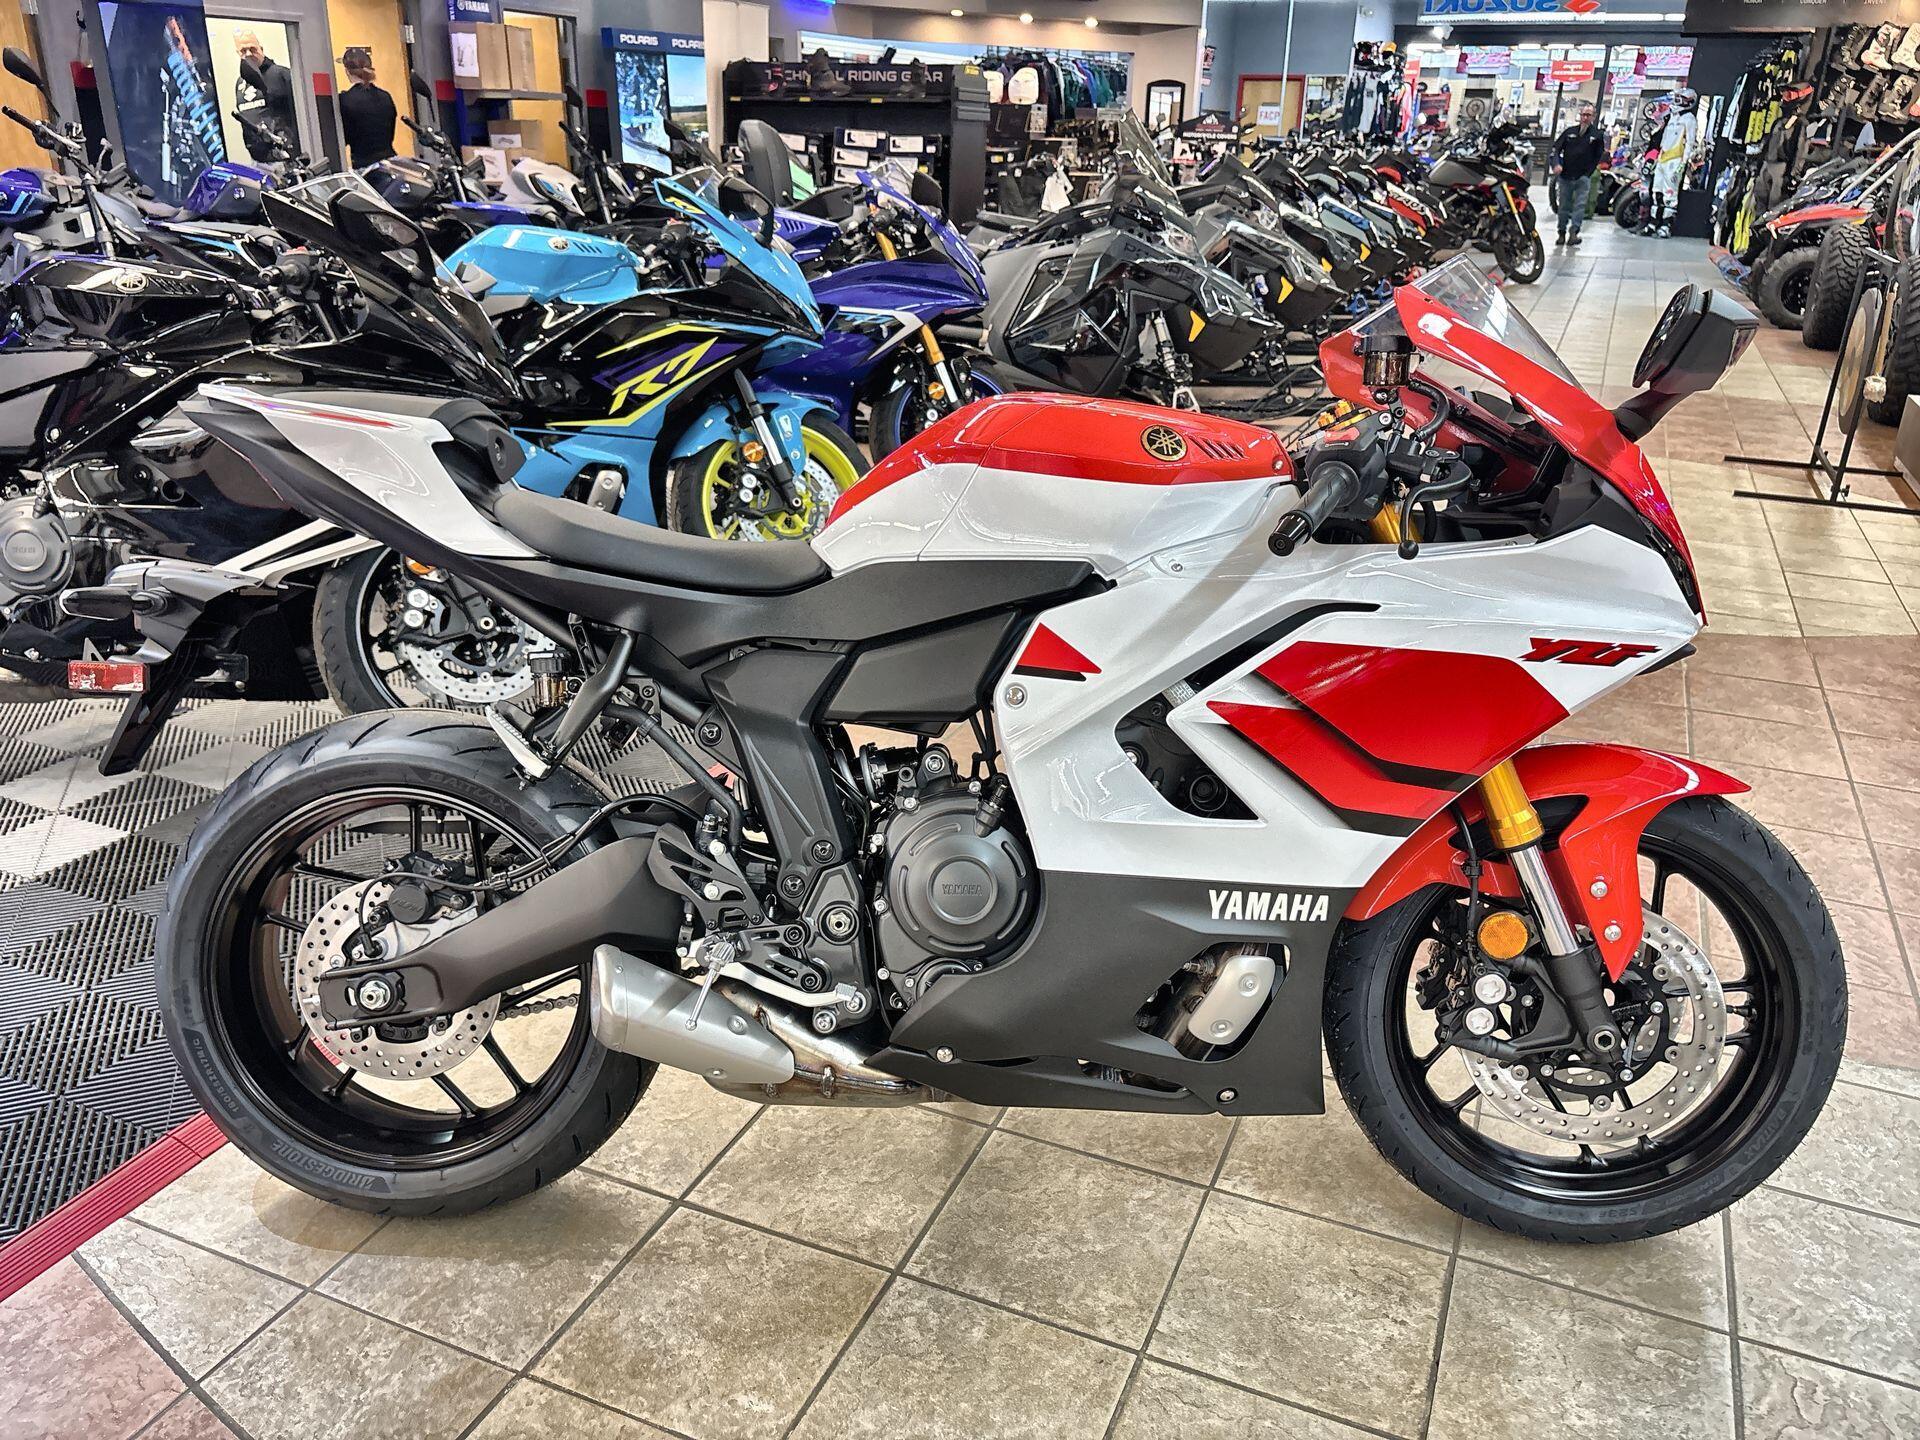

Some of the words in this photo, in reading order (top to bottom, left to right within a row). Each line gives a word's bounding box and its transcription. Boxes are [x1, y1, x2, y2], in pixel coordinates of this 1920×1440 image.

[620, 34, 659, 46] POLARIS
[847, 70, 897, 82] RIDING
[901, 71, 943, 83] GAR
[608, 336, 719, 416] R7
[1517, 637, 1663, 667] YZF
[941, 883, 983, 897] YAMAHA
[1208, 889, 1329, 922] YAMAHA
[270, 1141, 377, 1191] BRIDGESTONE
